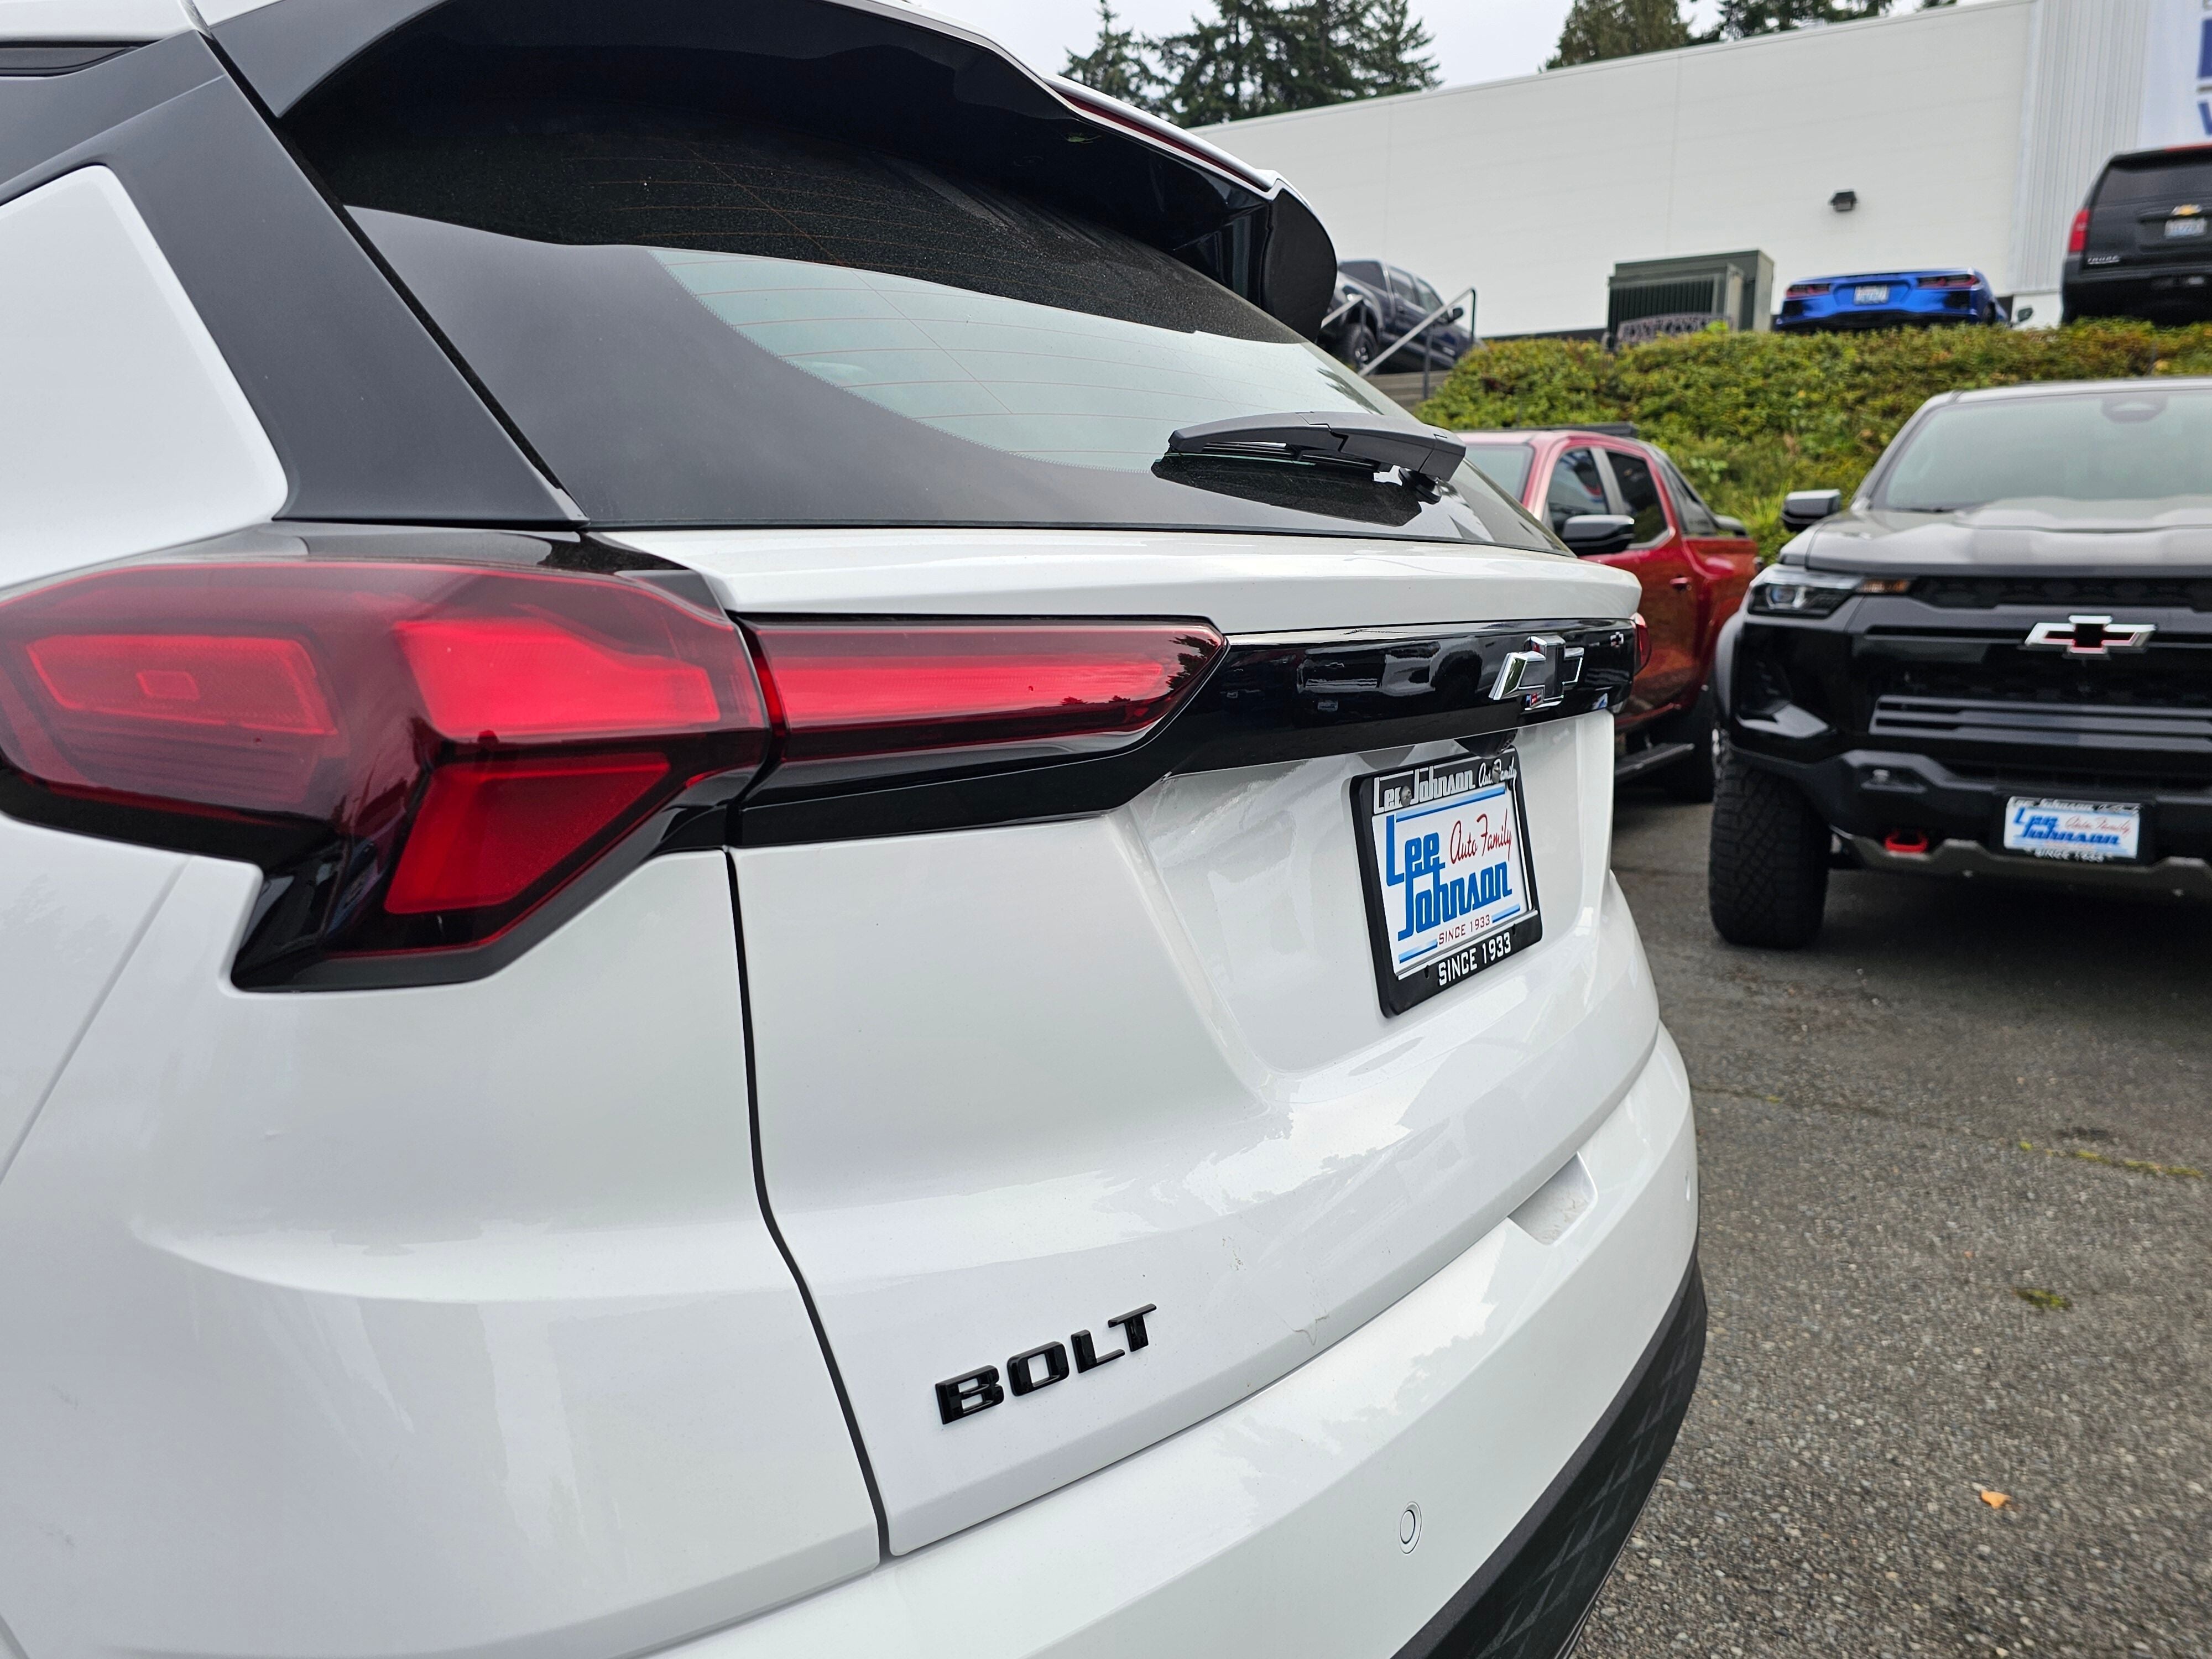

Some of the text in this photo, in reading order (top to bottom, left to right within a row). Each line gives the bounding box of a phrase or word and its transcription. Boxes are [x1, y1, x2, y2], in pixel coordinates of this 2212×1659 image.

[1410, 765, 1476, 805] Johnson
[1386, 809, 1512, 887] Lee Auto Family
[1397, 860, 1512, 941] Johnson
[1439, 914, 1490, 945] SINCE 1933
[1438, 931, 1511, 986] SINCE 1933
[935, 1303, 1157, 1425] BOLT
